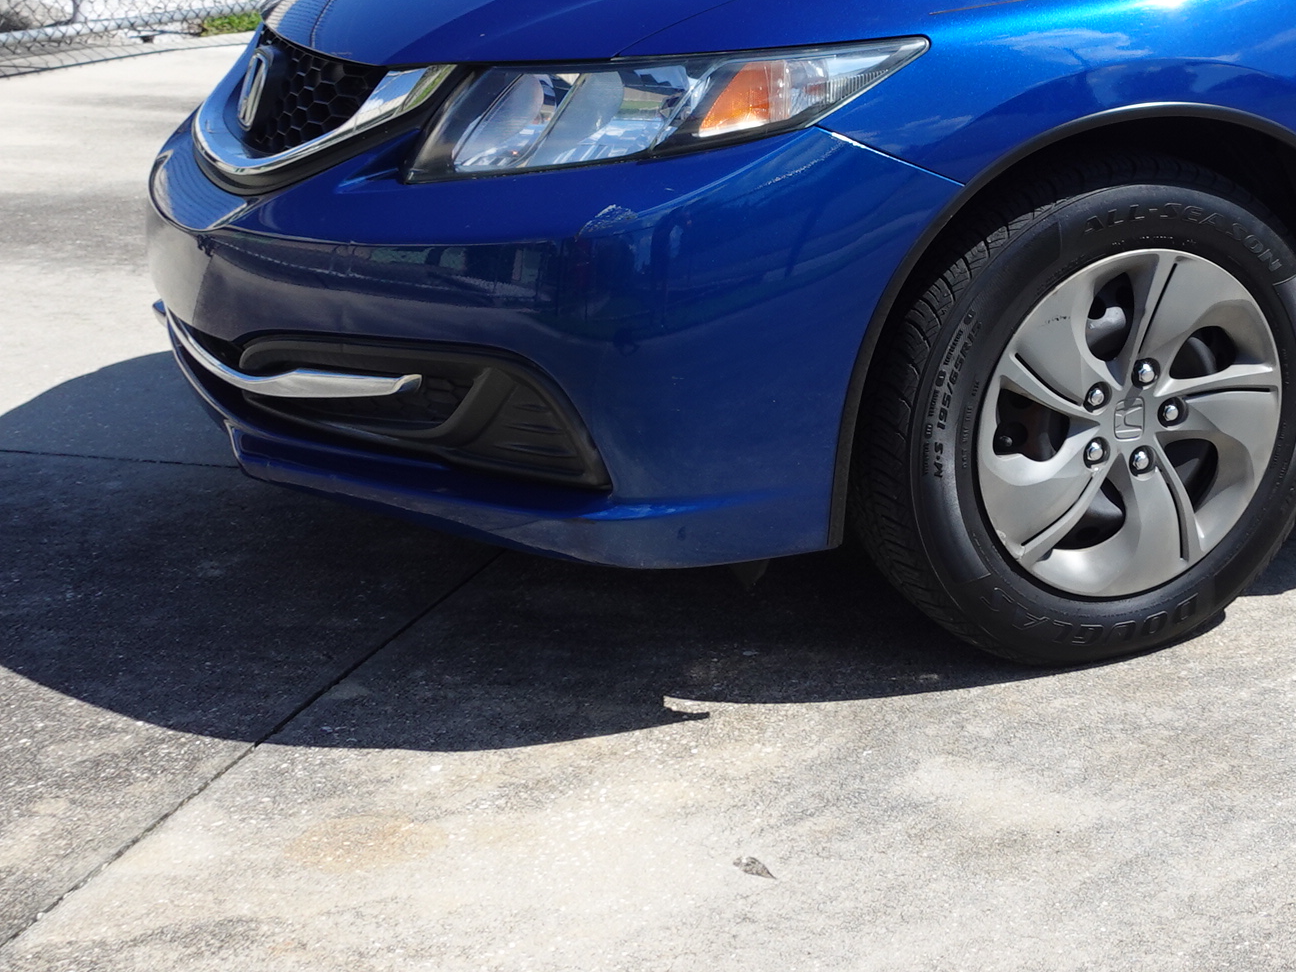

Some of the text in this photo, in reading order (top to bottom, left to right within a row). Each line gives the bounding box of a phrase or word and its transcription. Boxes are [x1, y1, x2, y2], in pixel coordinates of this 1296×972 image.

[1083, 202, 1283, 272] ALL-SEASON
[936, 321, 983, 430] 195/65R15
[980, 587, 1199, 646] DOUGLAS
